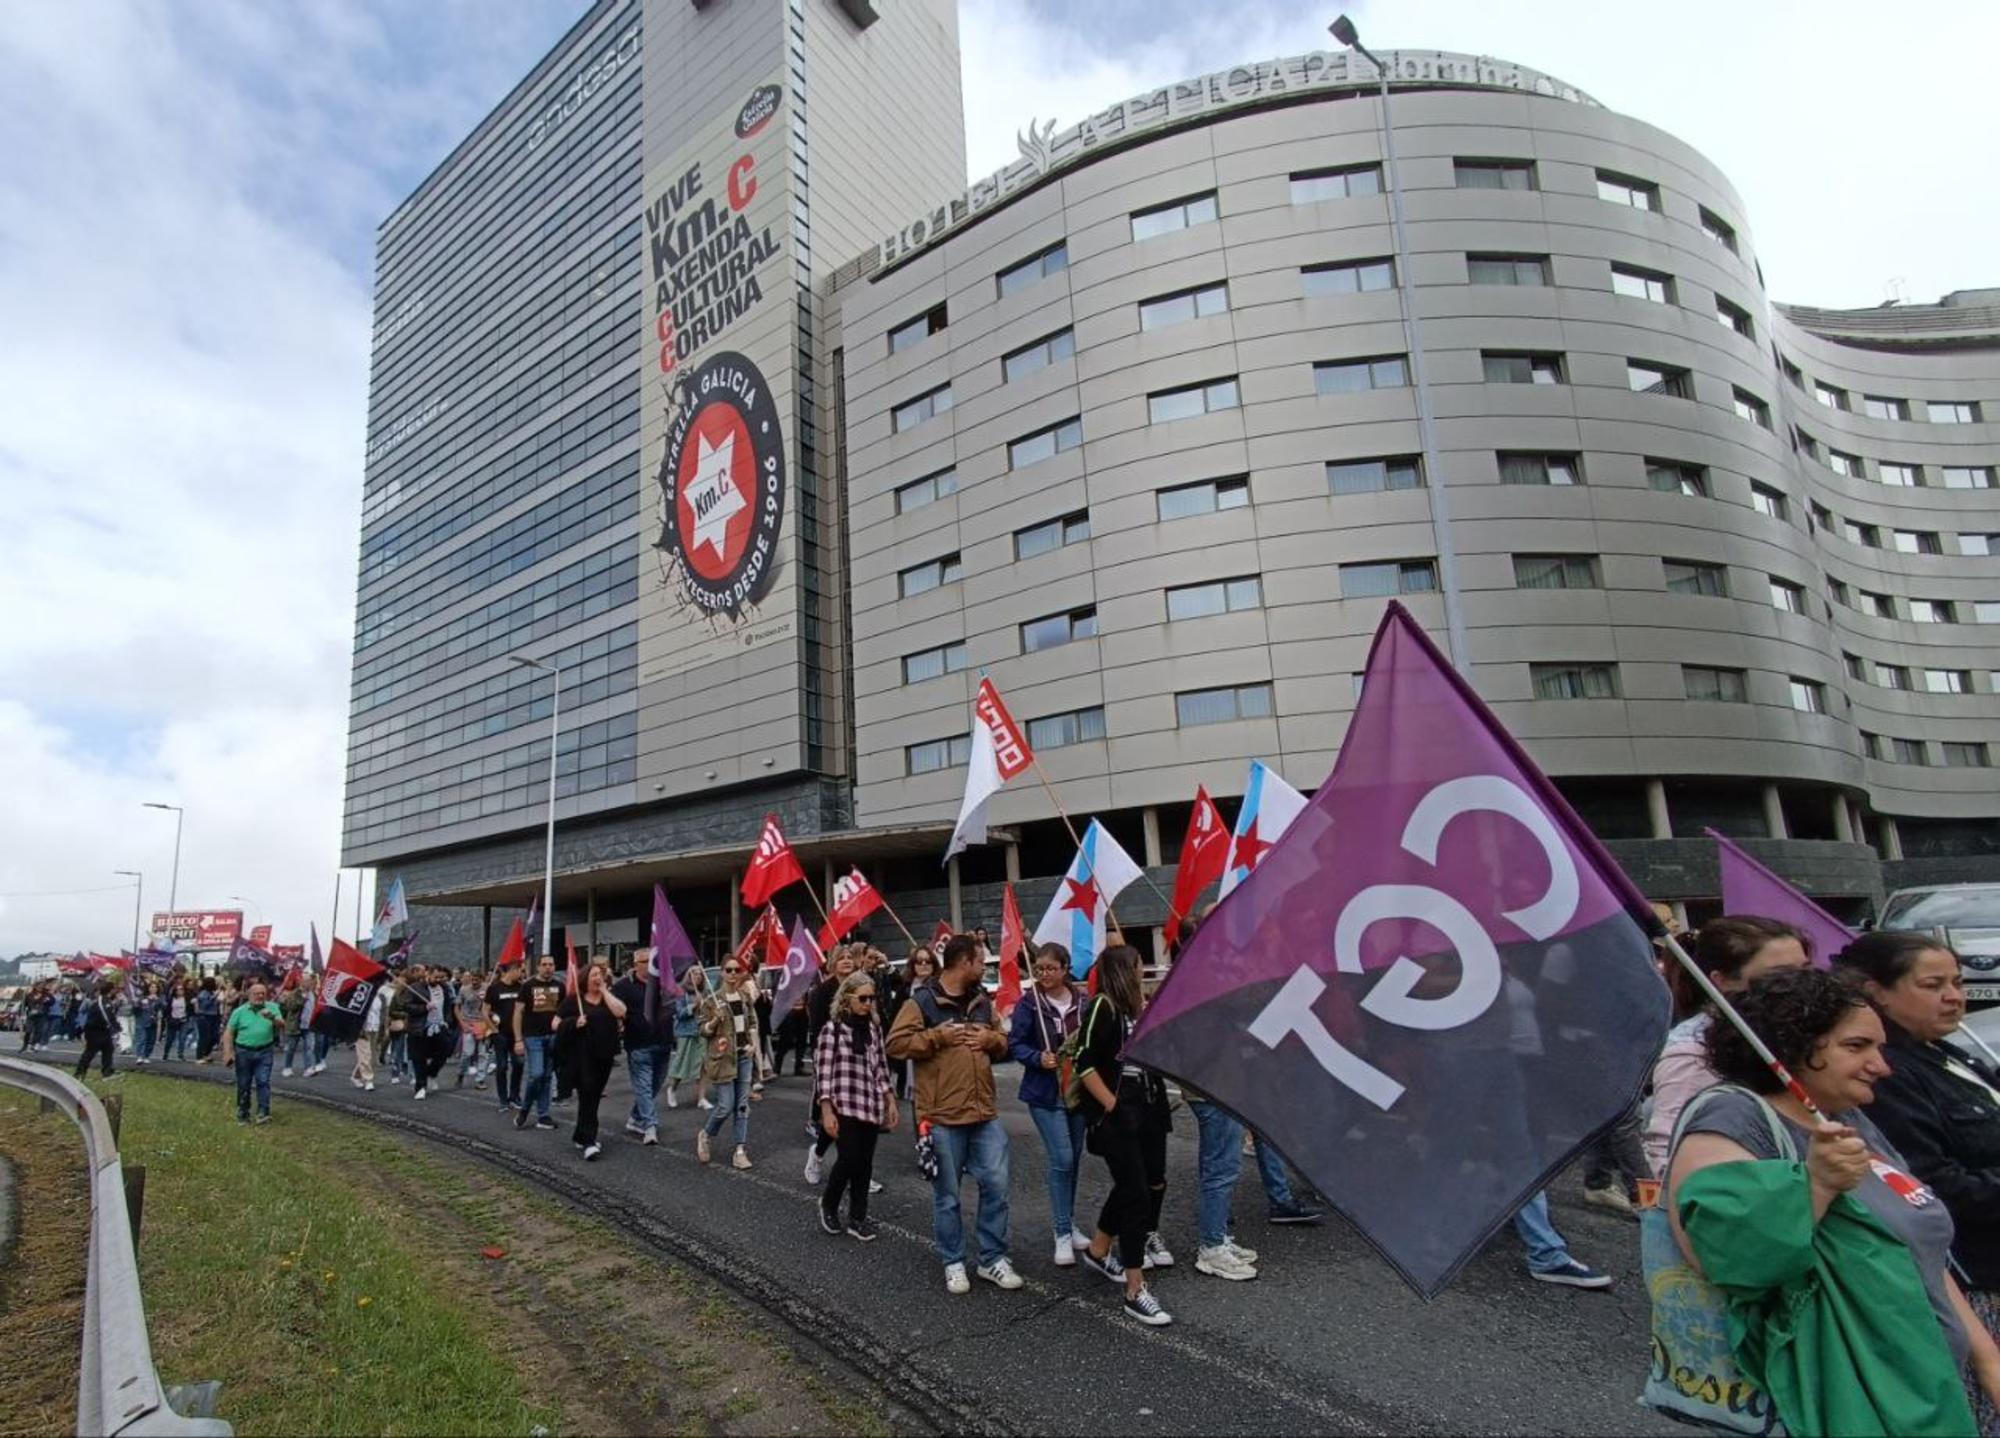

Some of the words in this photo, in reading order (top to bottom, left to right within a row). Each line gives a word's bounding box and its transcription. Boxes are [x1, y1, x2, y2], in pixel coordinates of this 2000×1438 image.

[528, 26, 639, 150] endesa
[644, 161, 704, 234] VIVE
[651, 153, 757, 283] Km.C
[656, 213, 752, 315] AXENDA
[656, 227, 781, 342] CULTURAL
[667, 391, 699, 501] ESTRELLA
[701, 366, 756, 411] GALICIA
[695, 468, 729, 521] Km.C
[733, 535, 769, 601] DESDE
[763, 455, 779, 530] 1906
